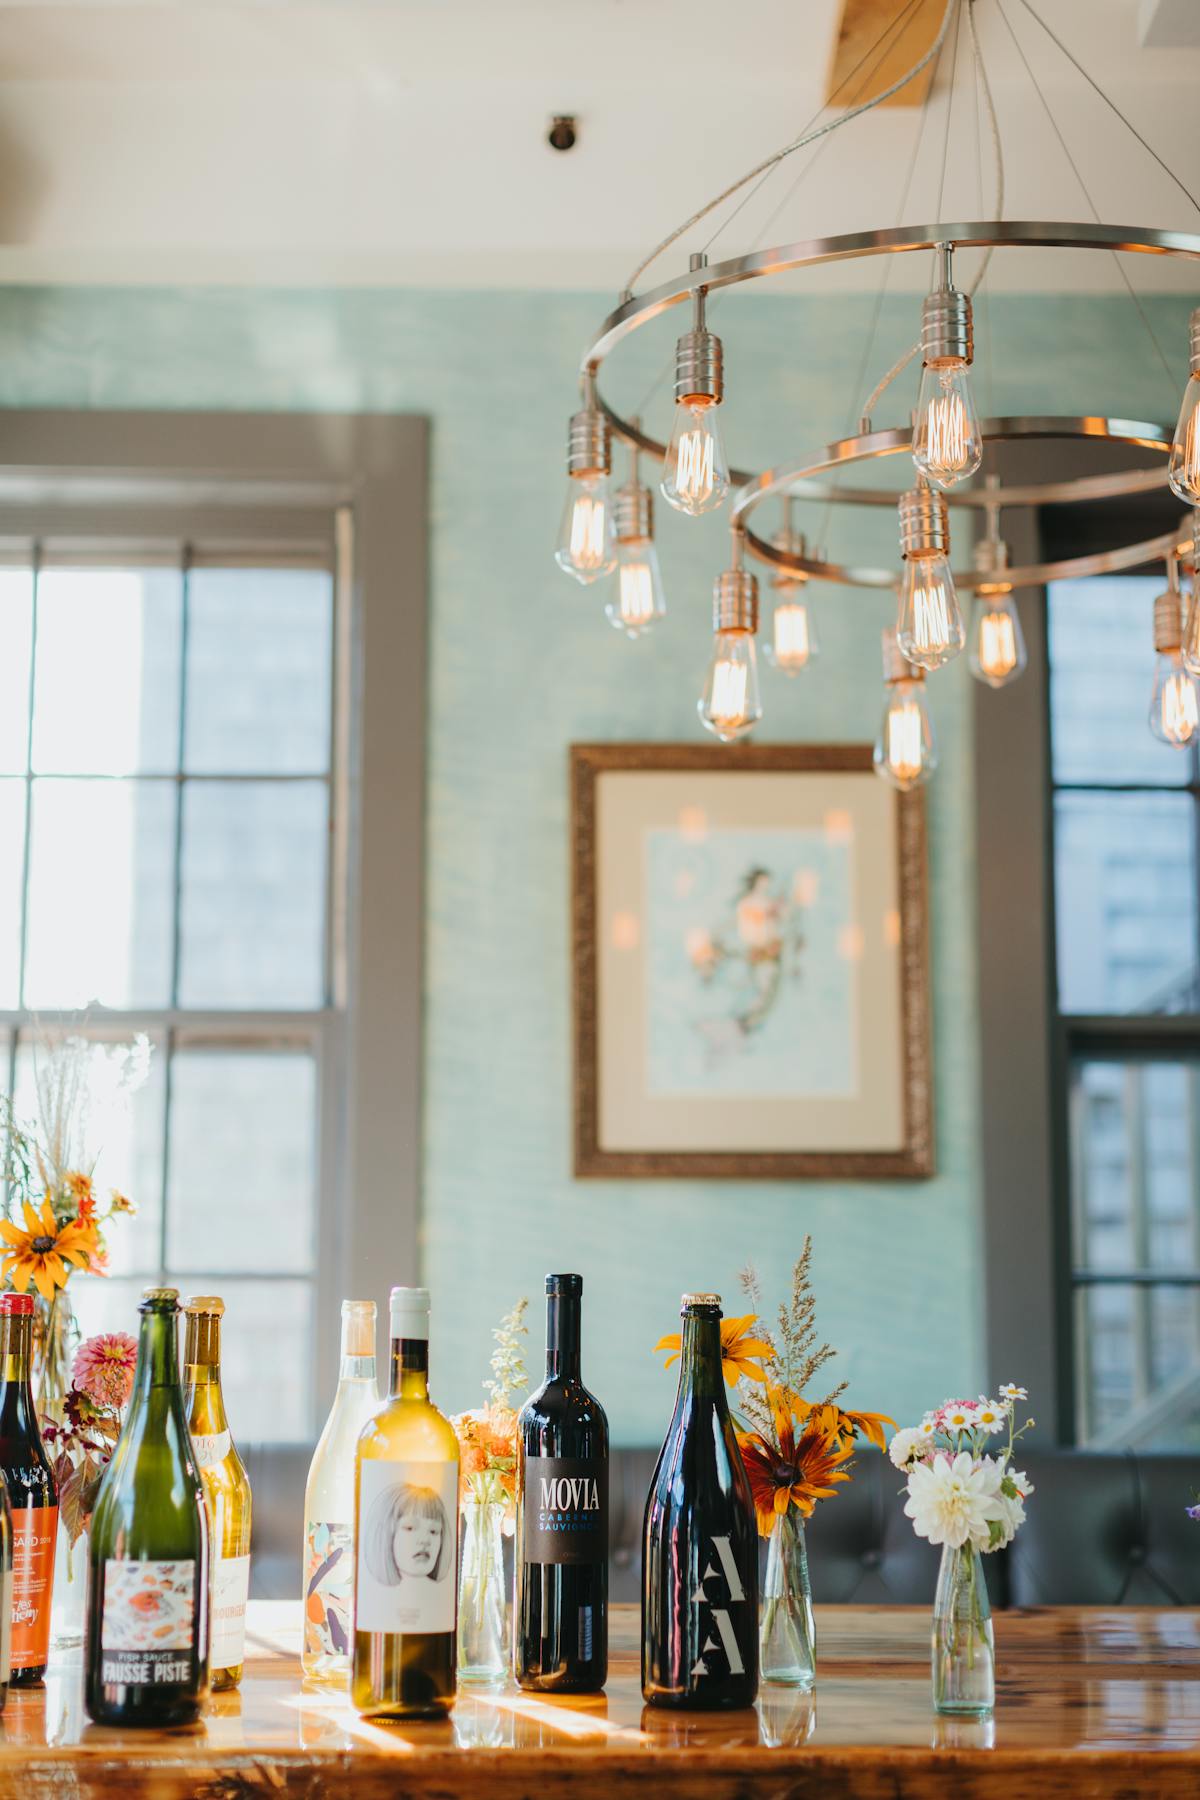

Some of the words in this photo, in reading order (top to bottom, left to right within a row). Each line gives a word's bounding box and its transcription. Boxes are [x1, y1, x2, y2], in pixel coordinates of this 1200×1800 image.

[540, 1477, 600, 1511] MOVIA
[540, 1523, 598, 1531] SAUVIGNO
[118, 1653, 140, 1661] FISH
[142, 1653, 173, 1661] SAUCE
[103, 1661, 149, 1683] FAUSSE
[154, 1661, 190, 1683] PISTE
